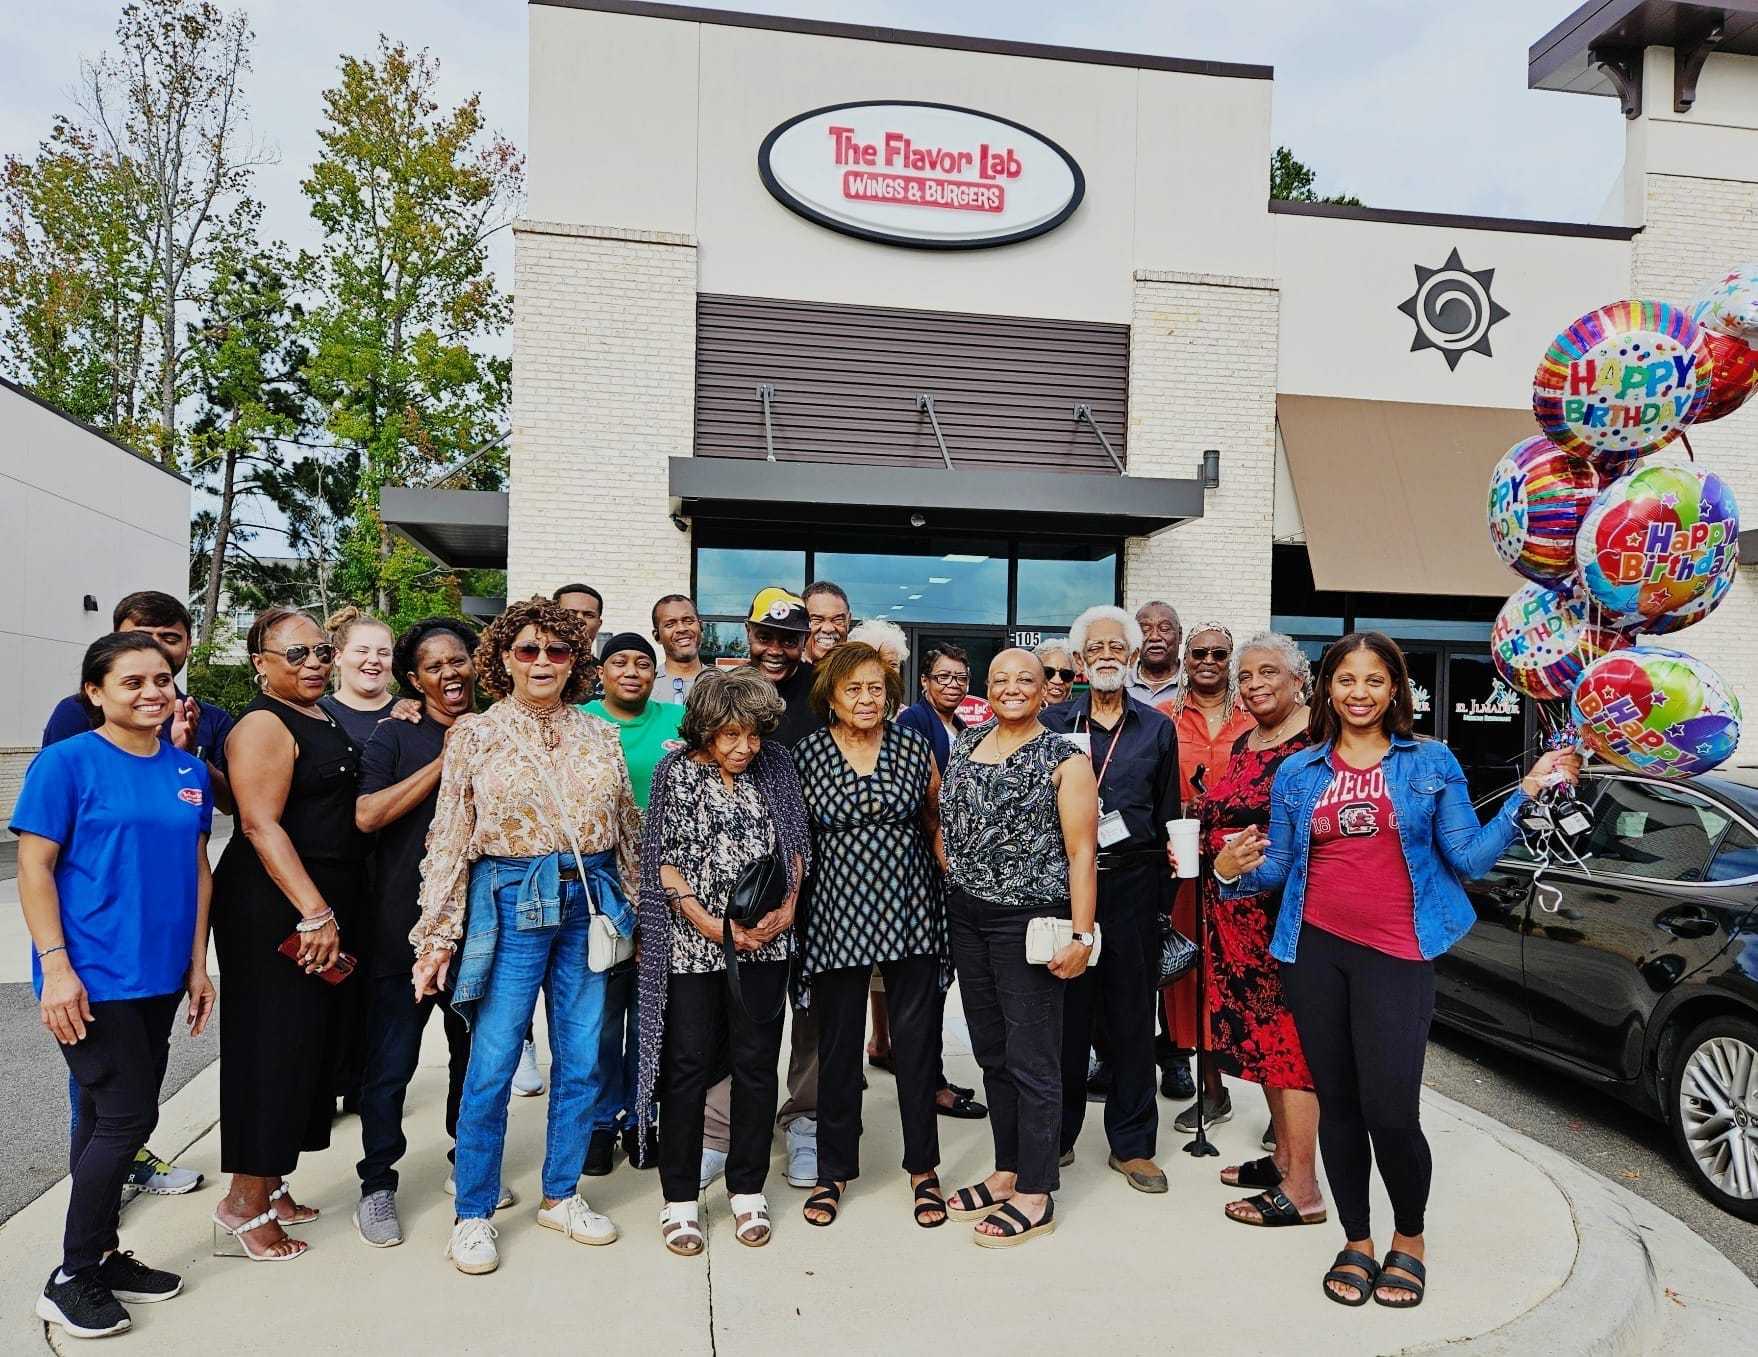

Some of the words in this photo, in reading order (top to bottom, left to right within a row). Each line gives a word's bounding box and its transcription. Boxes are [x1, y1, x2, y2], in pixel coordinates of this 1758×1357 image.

[828, 125, 877, 167] The
[884, 131, 973, 175] Flavor
[979, 143, 1022, 180] Lab
[848, 173, 904, 198] WINGS
[908, 183, 922, 202] &
[926, 181, 1000, 209] BURGERS
[1569, 354, 1697, 400] HAPPY
[1564, 394, 1692, 428] BIRTHDAY
[1643, 517, 1736, 556] Happy
[1017, 632, 1040, 646] 105
[1313, 767, 1392, 810] MECO
